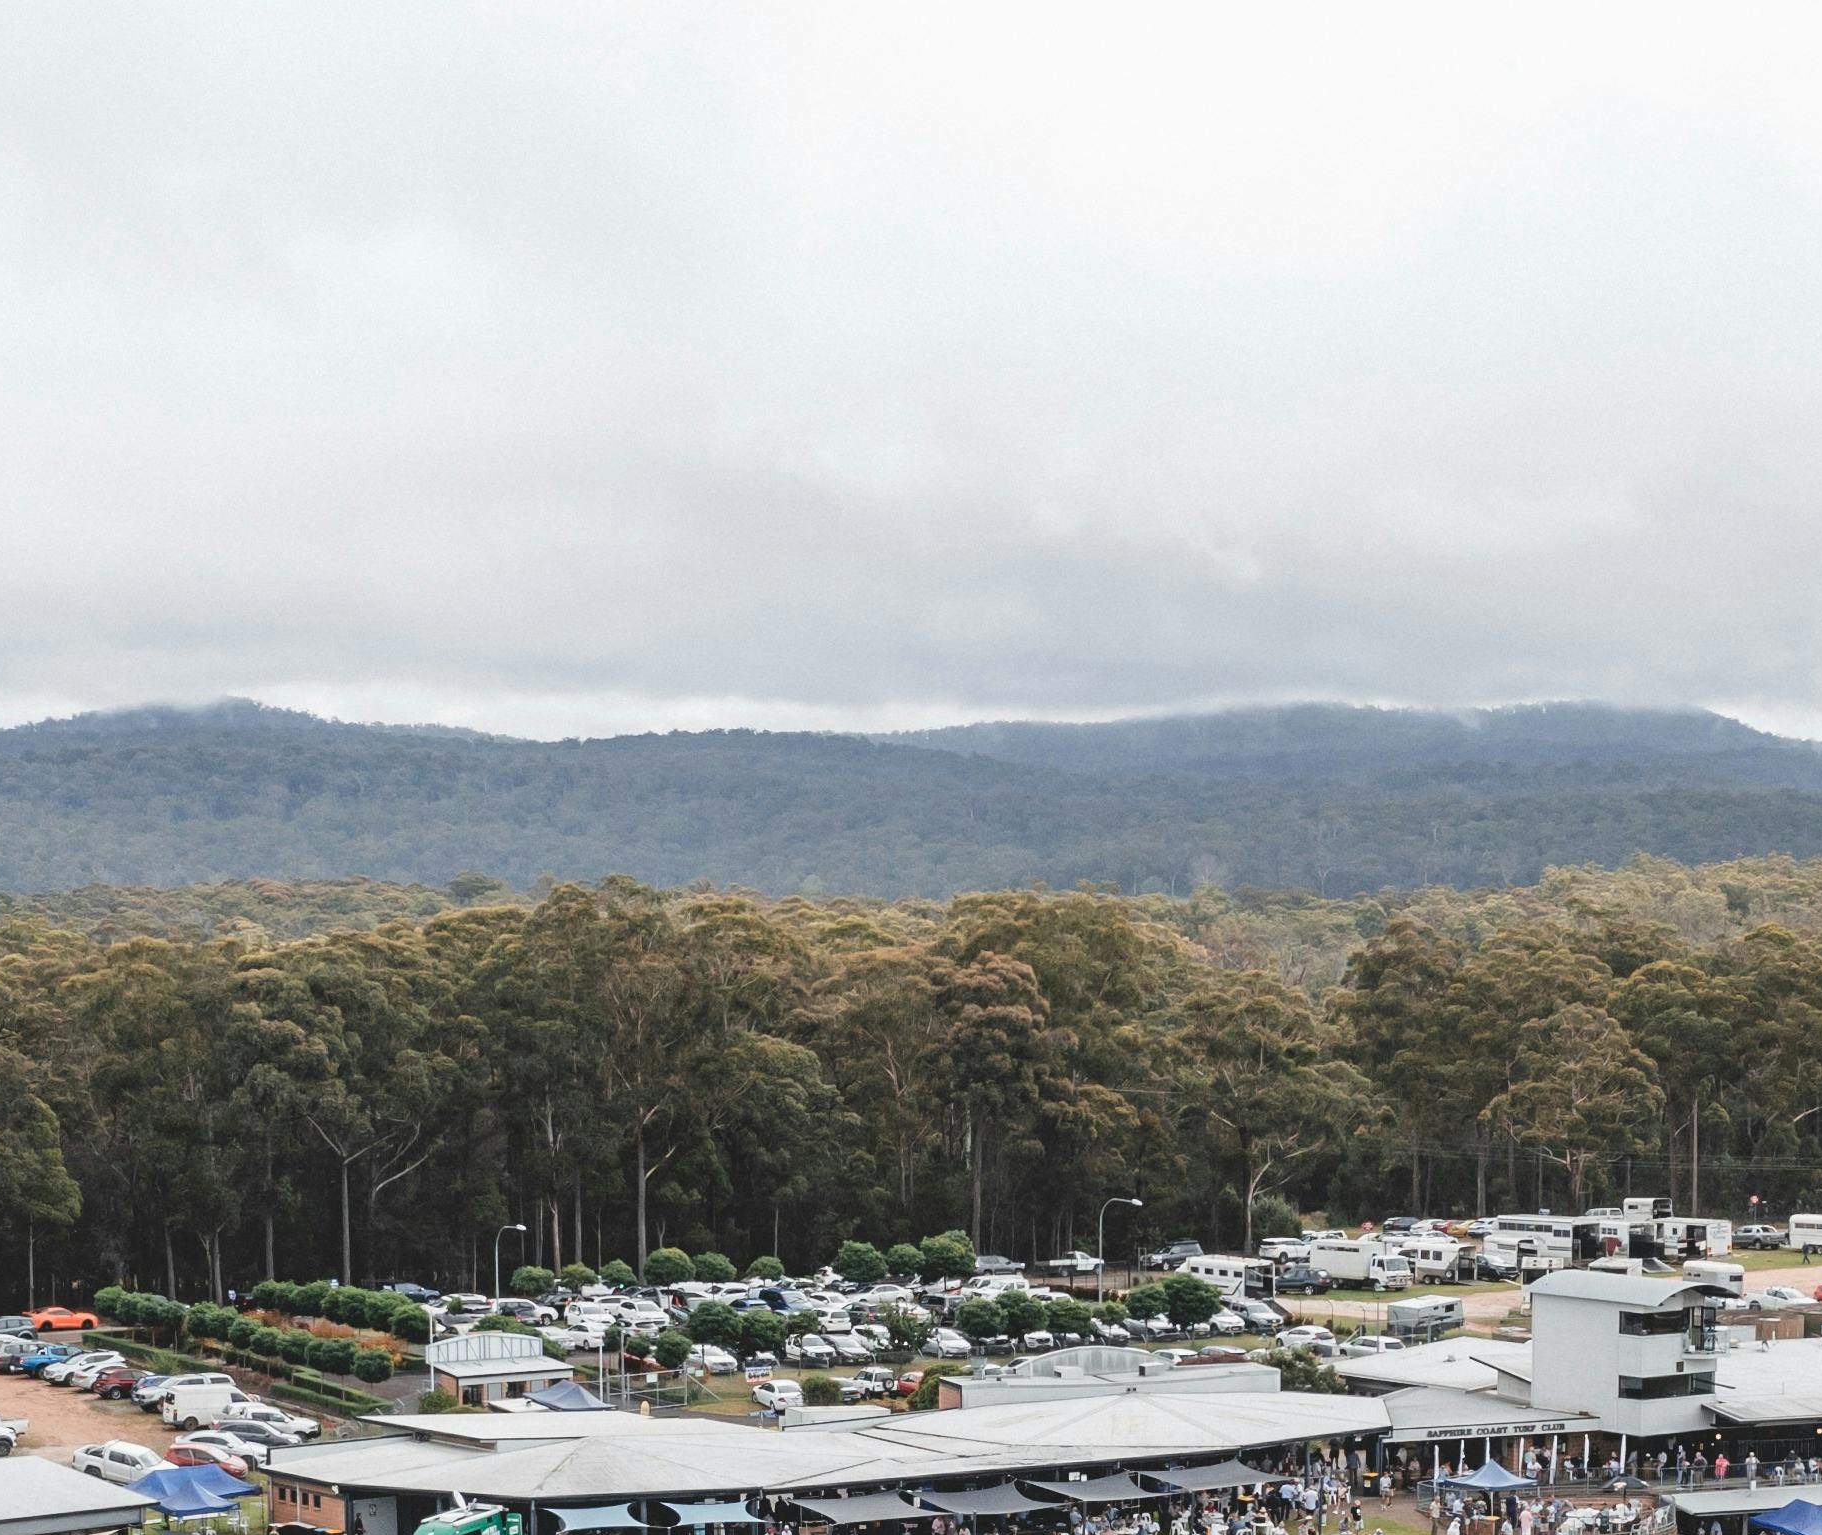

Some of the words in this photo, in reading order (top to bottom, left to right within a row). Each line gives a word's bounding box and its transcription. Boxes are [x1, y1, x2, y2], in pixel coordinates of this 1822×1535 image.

[1427, 1428, 1472, 1438] SAPPHIRE
[1476, 1426, 1508, 1435] COAST
[1514, 1425, 1536, 1433] TURF
[1541, 1423, 1565, 1431] CLUB
